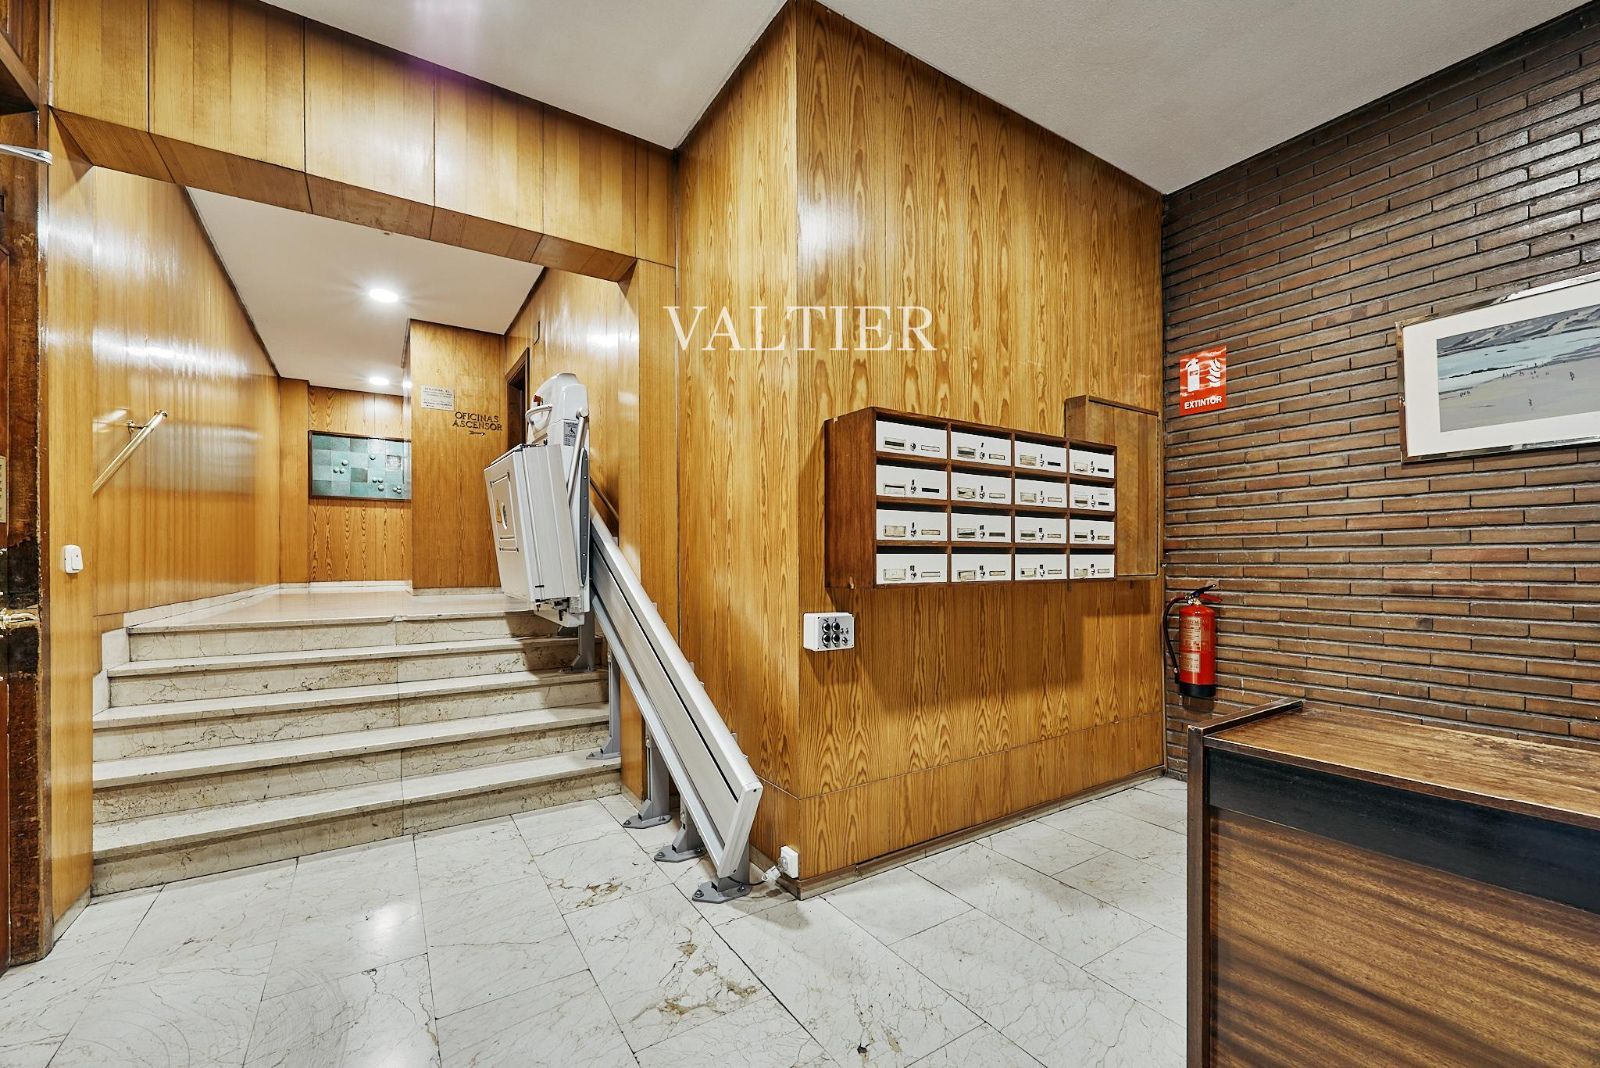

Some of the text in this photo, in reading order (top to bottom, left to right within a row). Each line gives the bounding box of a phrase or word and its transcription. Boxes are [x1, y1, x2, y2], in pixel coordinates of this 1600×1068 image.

[1184, 395, 1222, 409] EXTINTOR
[455, 411, 499, 423] OFICINAS
[452, 420, 503, 431] ASCENSOR
